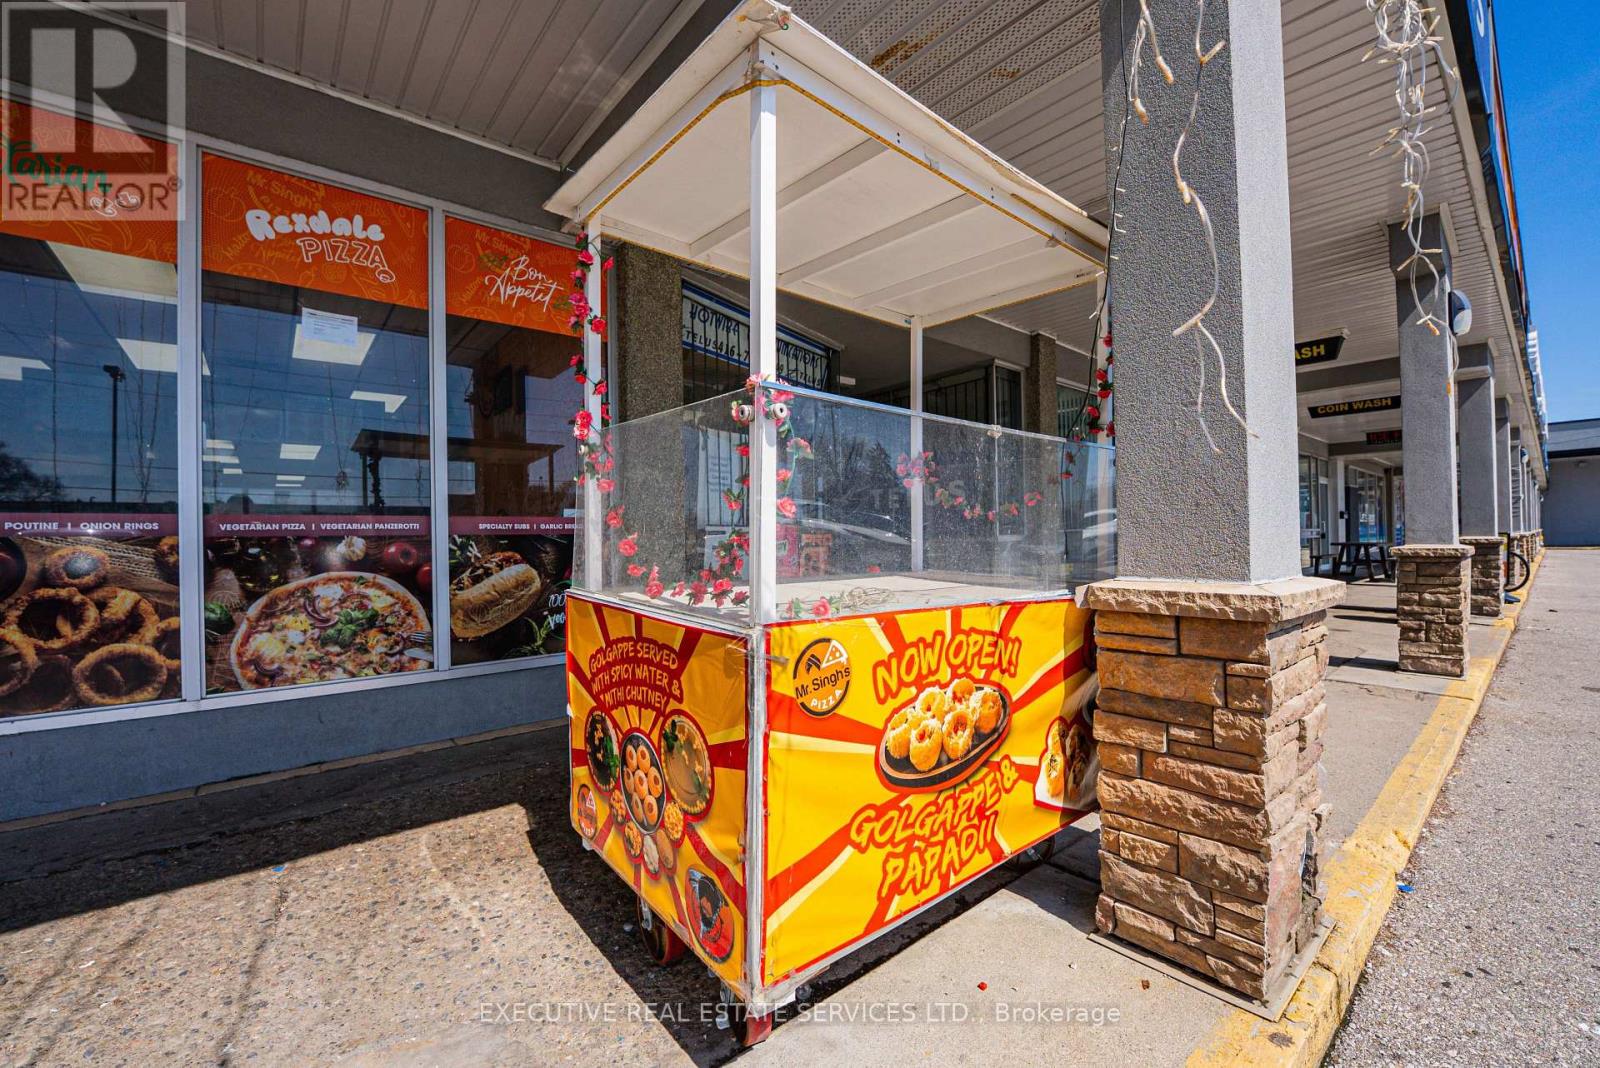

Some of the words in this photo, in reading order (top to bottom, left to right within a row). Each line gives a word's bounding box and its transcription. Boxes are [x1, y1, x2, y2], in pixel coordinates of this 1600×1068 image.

[245, 209, 385, 241] Rexdale
[296, 237, 389, 271] PIZZA
[511, 255, 552, 284] Bon
[485, 267, 564, 312] Appetit
[1317, 403, 1349, 414] COIN
[1352, 398, 1392, 410] WASH
[4, 522, 59, 530] POUTINE
[80, 522, 121, 530] ONION
[124, 522, 159, 530] RINGS
[219, 523, 279, 531] VEGETARIAN
[590, 641, 635, 673] GOLGAPPE
[636, 642, 679, 670] SERVED
[875, 634, 944, 702] NOW
[947, 632, 1020, 675] OPEN!
[591, 670, 611, 695] WITH
[611, 663, 634, 683] SPICY
[634, 663, 670, 693] WATER
[671, 680, 681, 698] &
[795, 684, 812, 699] Mr.
[625, 685, 667, 712] CHUTNEY
[810, 689, 843, 710] PIZZA
[849, 771, 999, 849] GOLGAPPE
[1000, 758, 1019, 791] &
